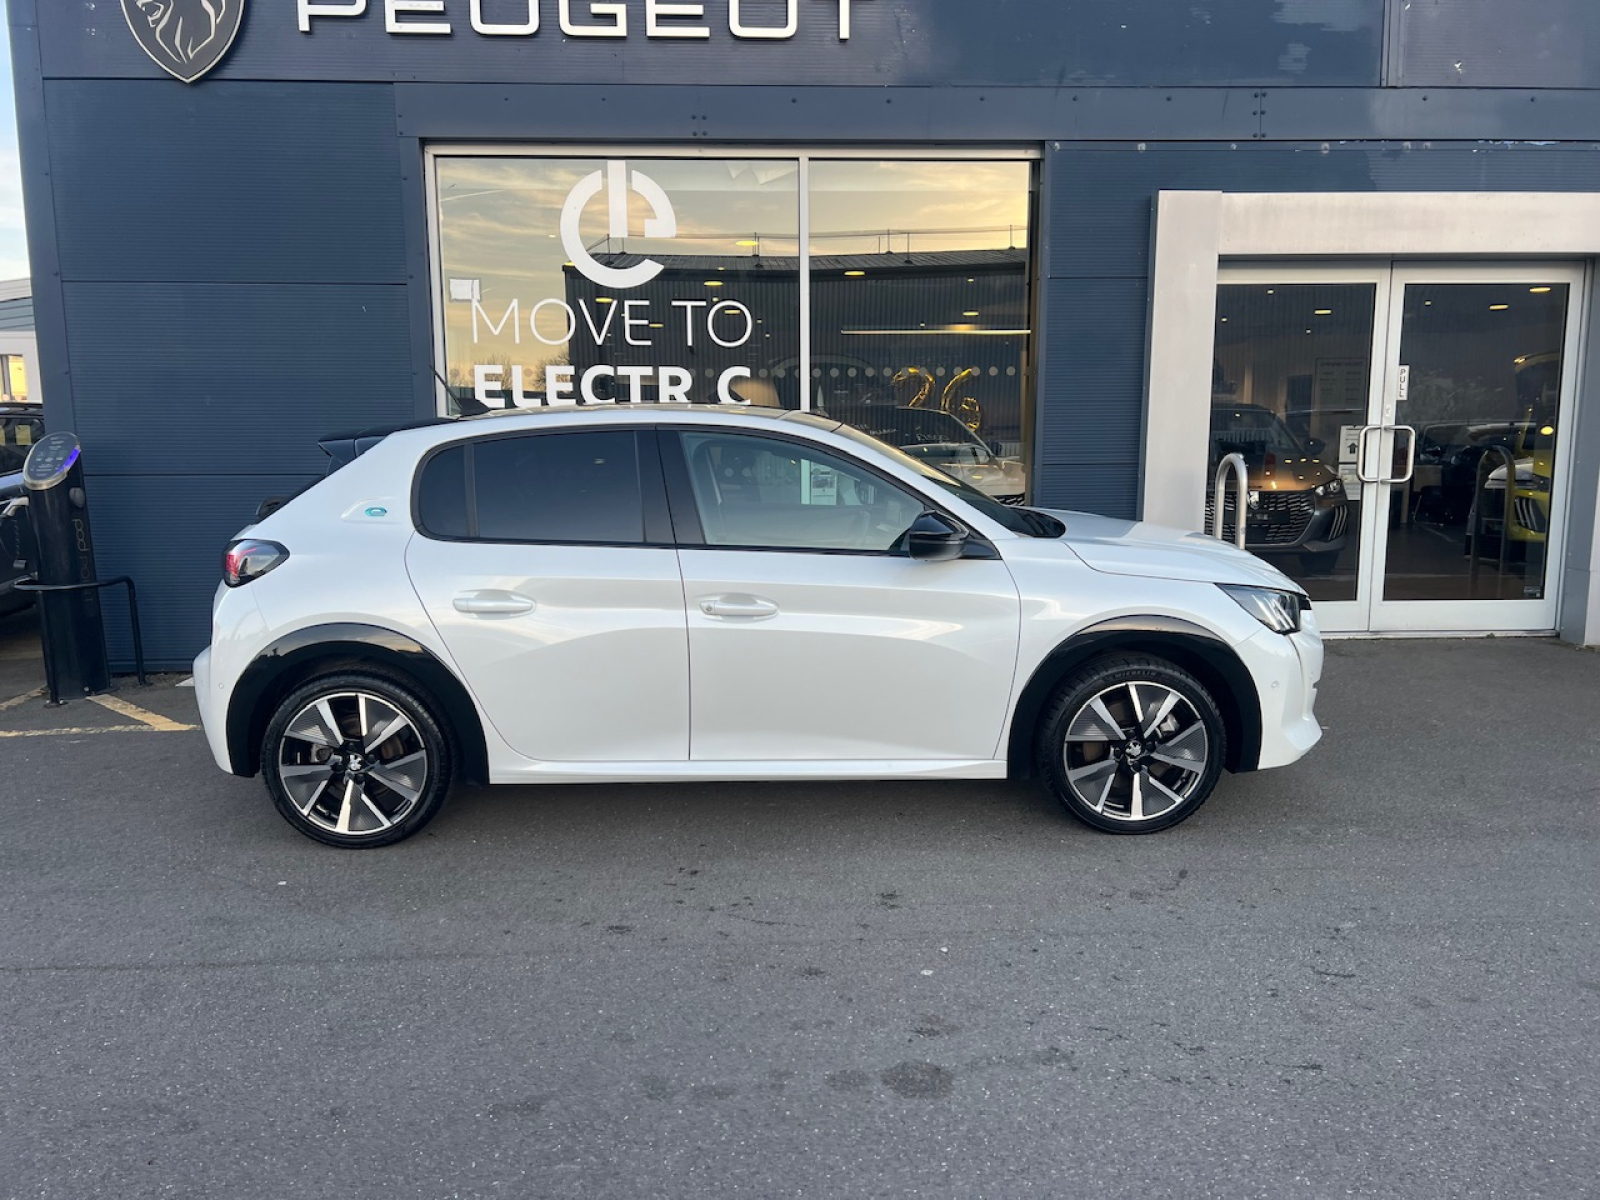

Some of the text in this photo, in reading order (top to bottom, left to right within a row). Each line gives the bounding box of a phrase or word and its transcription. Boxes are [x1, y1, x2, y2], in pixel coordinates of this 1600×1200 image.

[471, 298, 752, 348] MOVE TO
[1399, 368, 1407, 398] PULL
